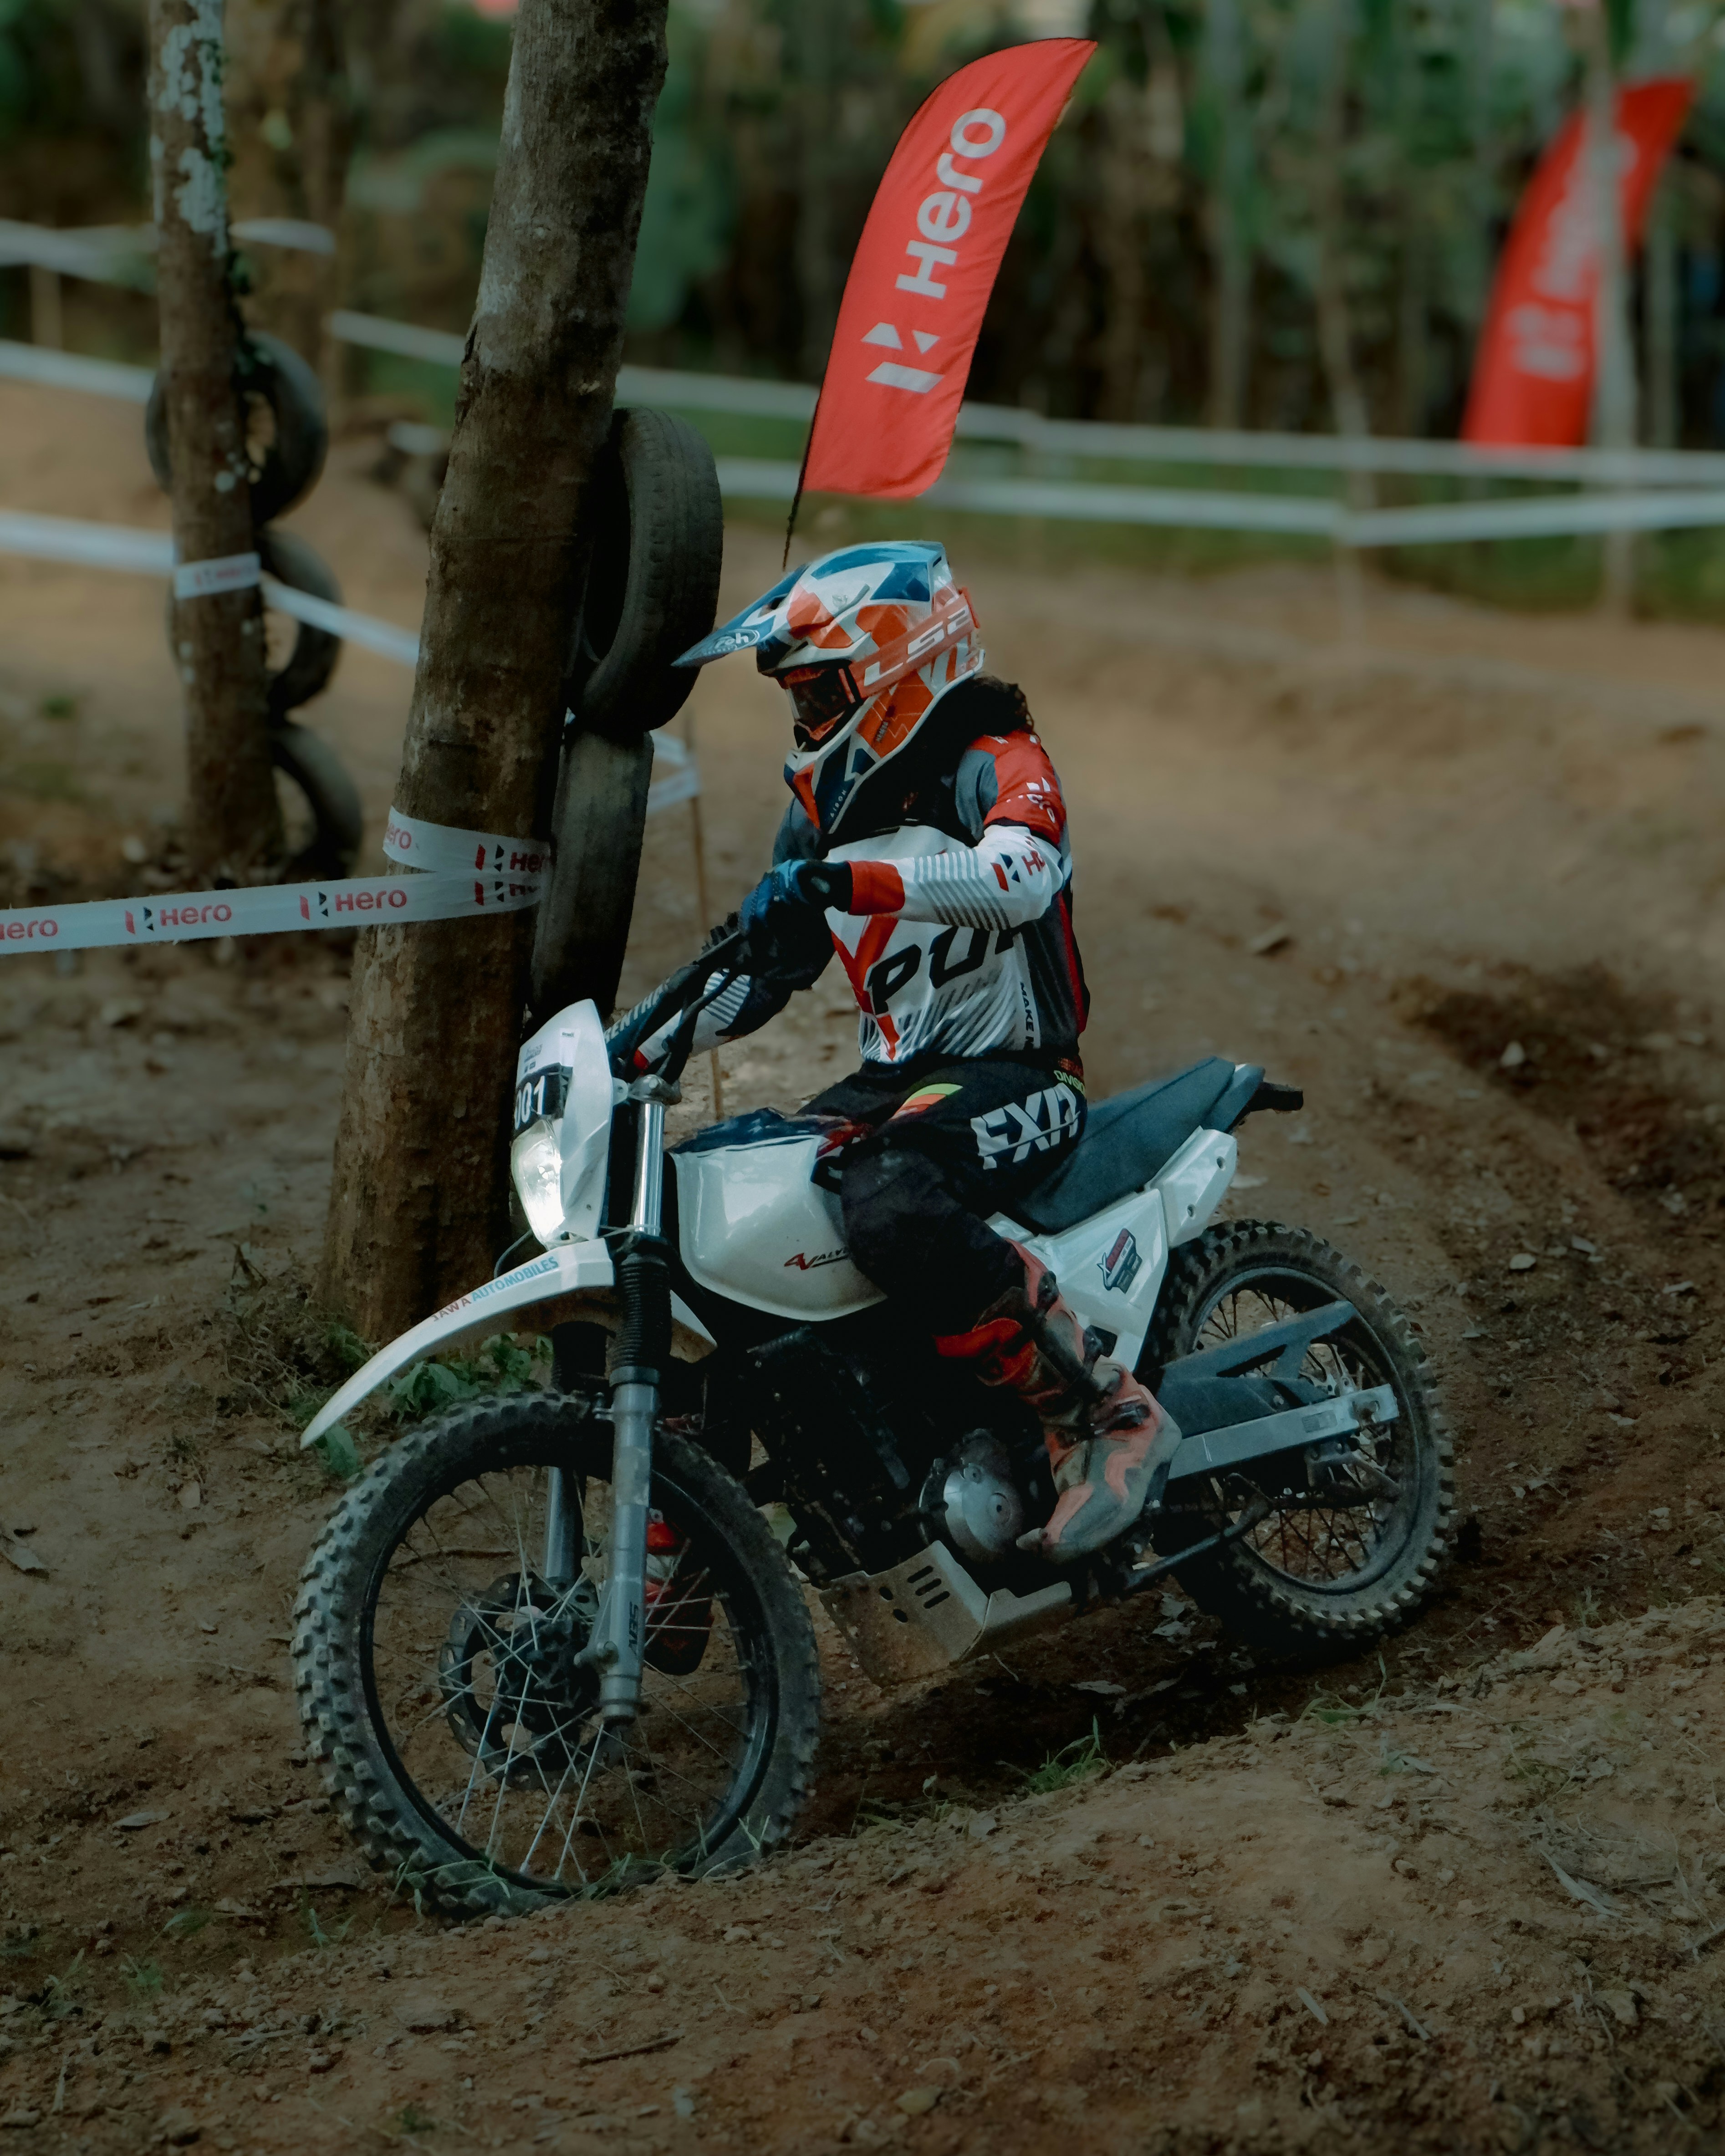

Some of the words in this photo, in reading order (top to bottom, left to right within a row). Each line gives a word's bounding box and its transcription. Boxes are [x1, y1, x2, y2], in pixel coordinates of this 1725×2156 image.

[895, 108, 1006, 299] Hero
[863, 605, 971, 687] LS2
[159, 903, 232, 927] Hero
[335, 889, 407, 912] Hero
[1020, 982, 1034, 1032] MAKE
[431, 1298, 472, 1322] JAWA
[471, 1256, 559, 1302] AUTOMOBILES
